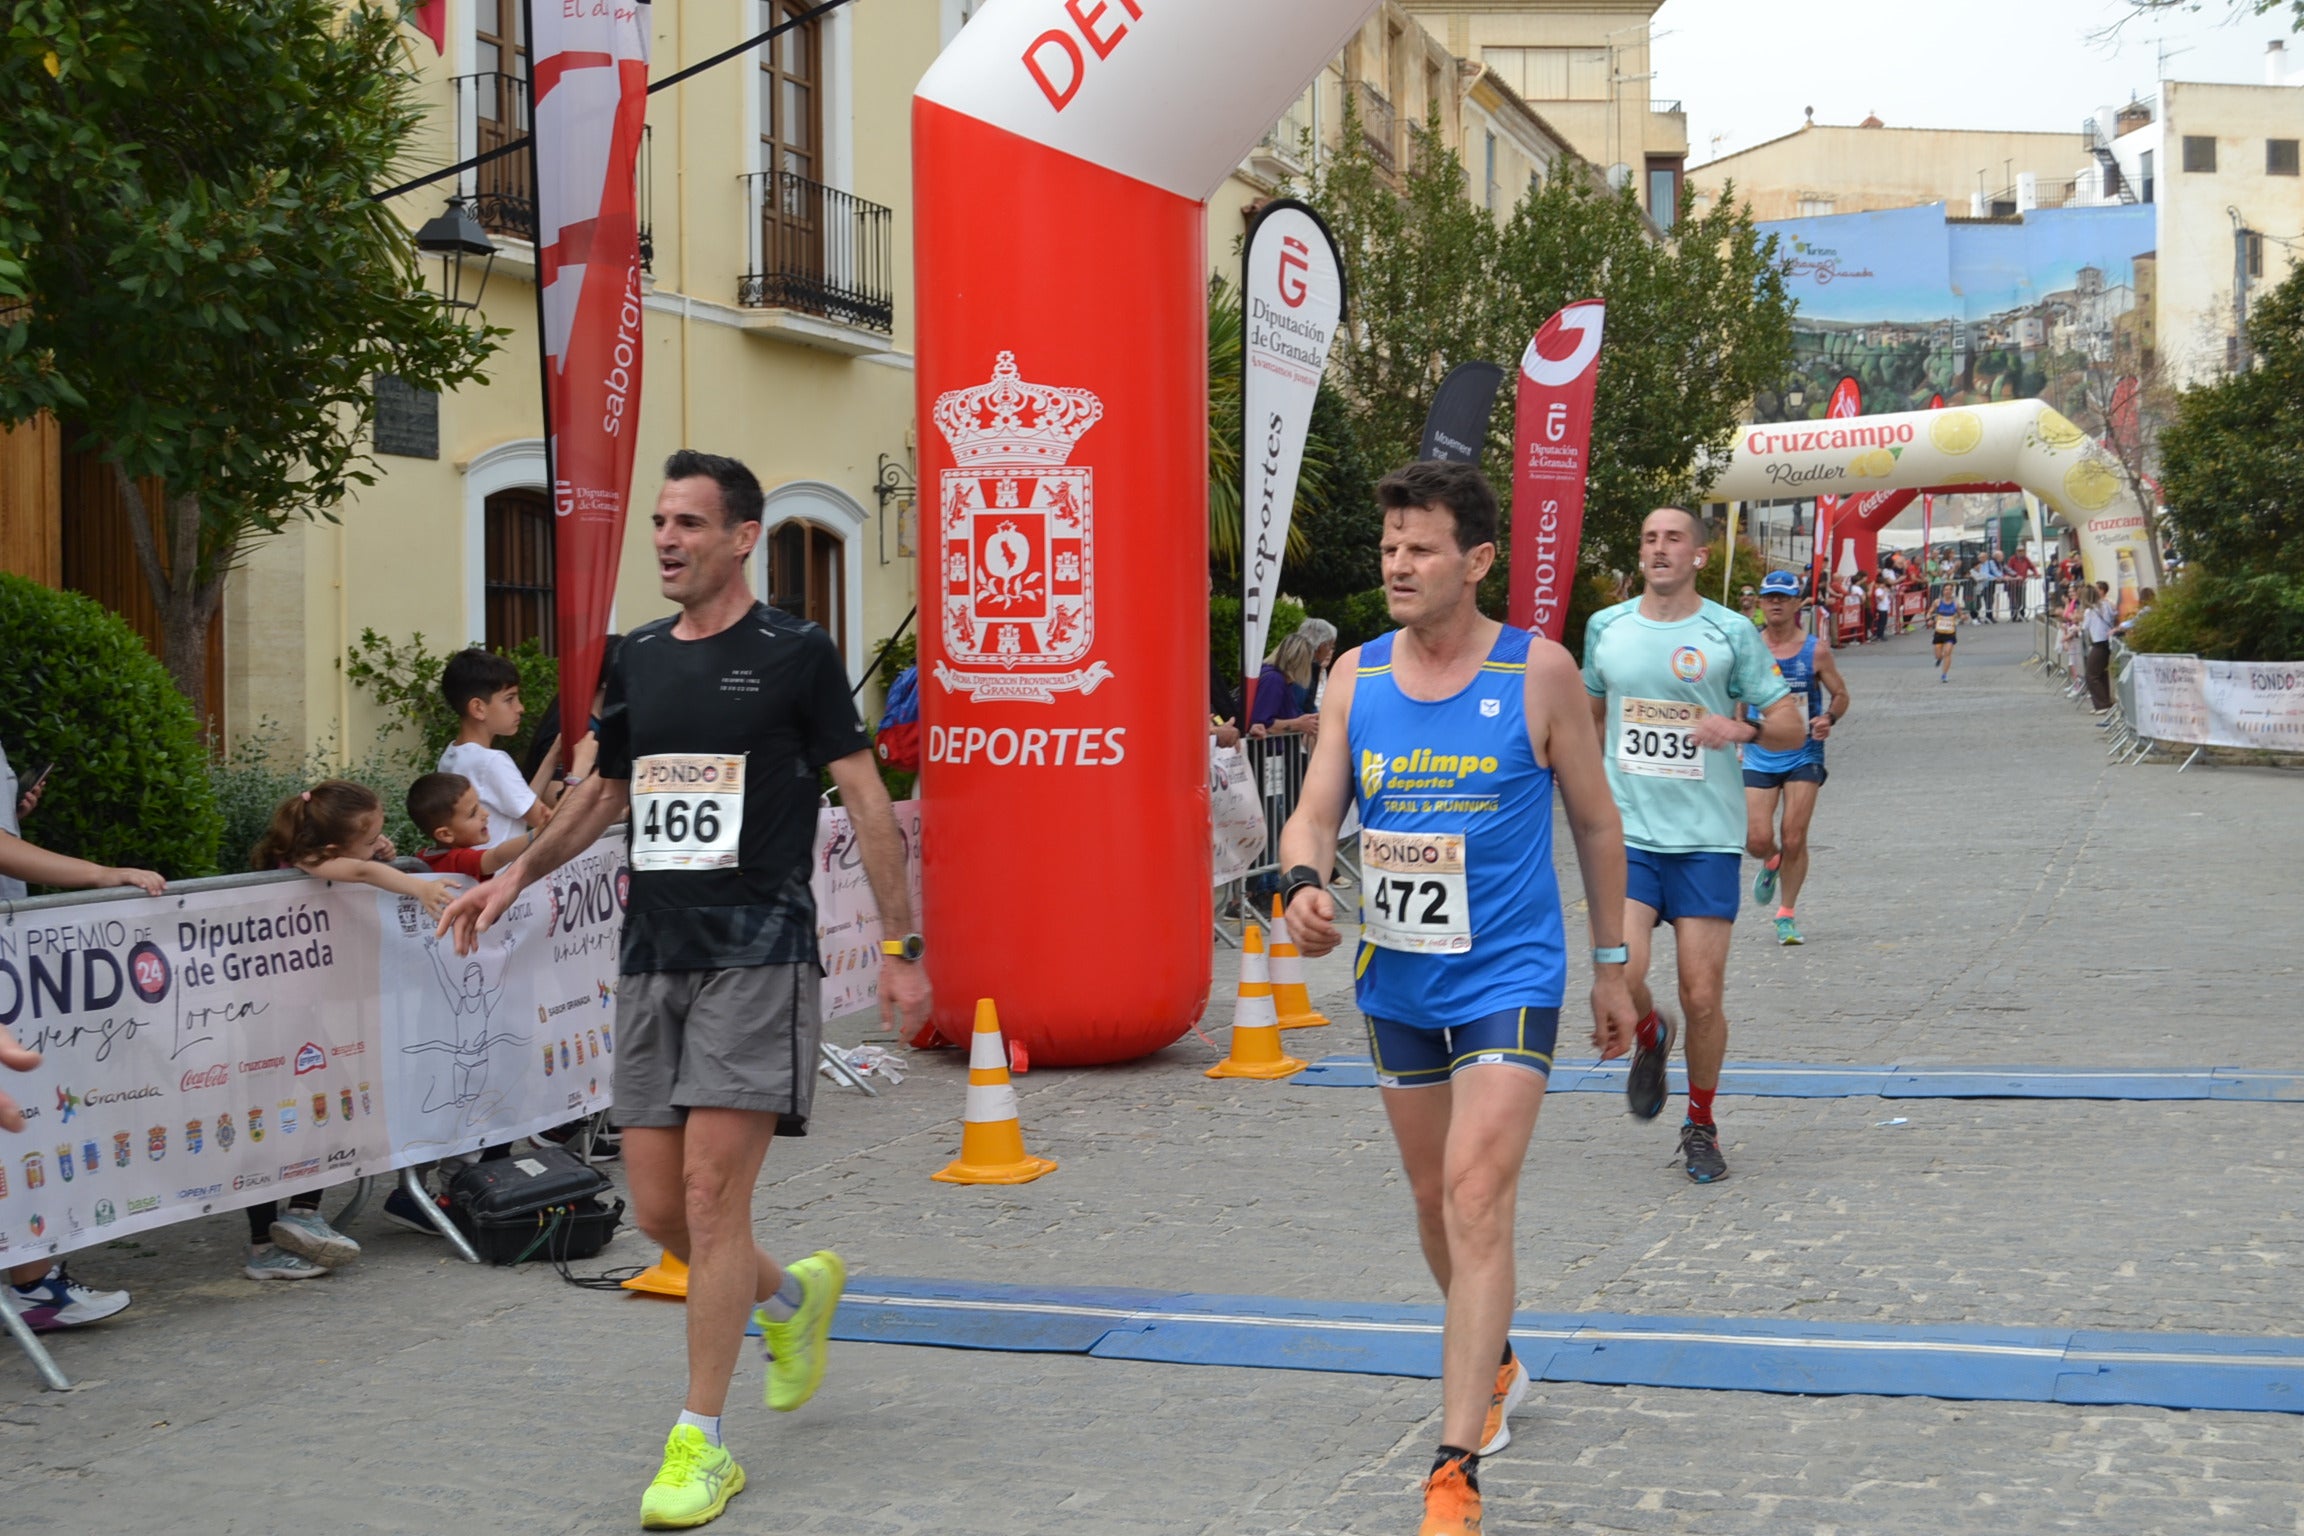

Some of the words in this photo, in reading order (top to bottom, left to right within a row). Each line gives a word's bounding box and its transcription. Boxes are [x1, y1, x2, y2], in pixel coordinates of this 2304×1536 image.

[1021, 0, 1143, 113] DE
[1805, 243, 1838, 256] Turismo
[1252, 297, 1325, 344] Diputación
[1251, 325, 1268, 347] de
[1270, 331, 1322, 368] Granada
[1434, 430, 1472, 456] Movement
[1530, 442, 1578, 456] Diputación
[1747, 423, 1914, 455] Cruzcampo
[1528, 455, 1538, 467] de
[1540, 456, 1578, 468] Granada
[1765, 461, 1847, 486] Radler
[2088, 515, 2148, 532] Cruzcam
[979, 684, 1042, 696] GRANADA
[2251, 672, 2295, 690] FONDO
[1637, 705, 1691, 720] FONDO
[928, 725, 1126, 766] DEPORTES
[1625, 729, 1697, 760] 3039
[649, 765, 718, 783] FONDO
[1391, 748, 1498, 779] olimpo
[1387, 775, 1455, 791] deportes
[1384, 800, 1418, 812] TRAIL
[1421, 800, 1432, 812] &
[1434, 800, 1499, 812] RUNNING
[643, 799, 721, 843] 466
[1375, 876, 1449, 925] 472
[27, 921, 126, 955] PREMIO
[134, 928, 152, 944] DE
[178, 904, 330, 958] Diputación
[137, 960, 163, 985] 24
[184, 957, 216, 988] de
[223, 939, 334, 982] Granada
[170, 965, 270, 1060] Lorca
[548, 1003, 566, 1017] SABOR
[238, 1055, 286, 1074] Cruzcampo
[84, 1083, 163, 1107] Granada
